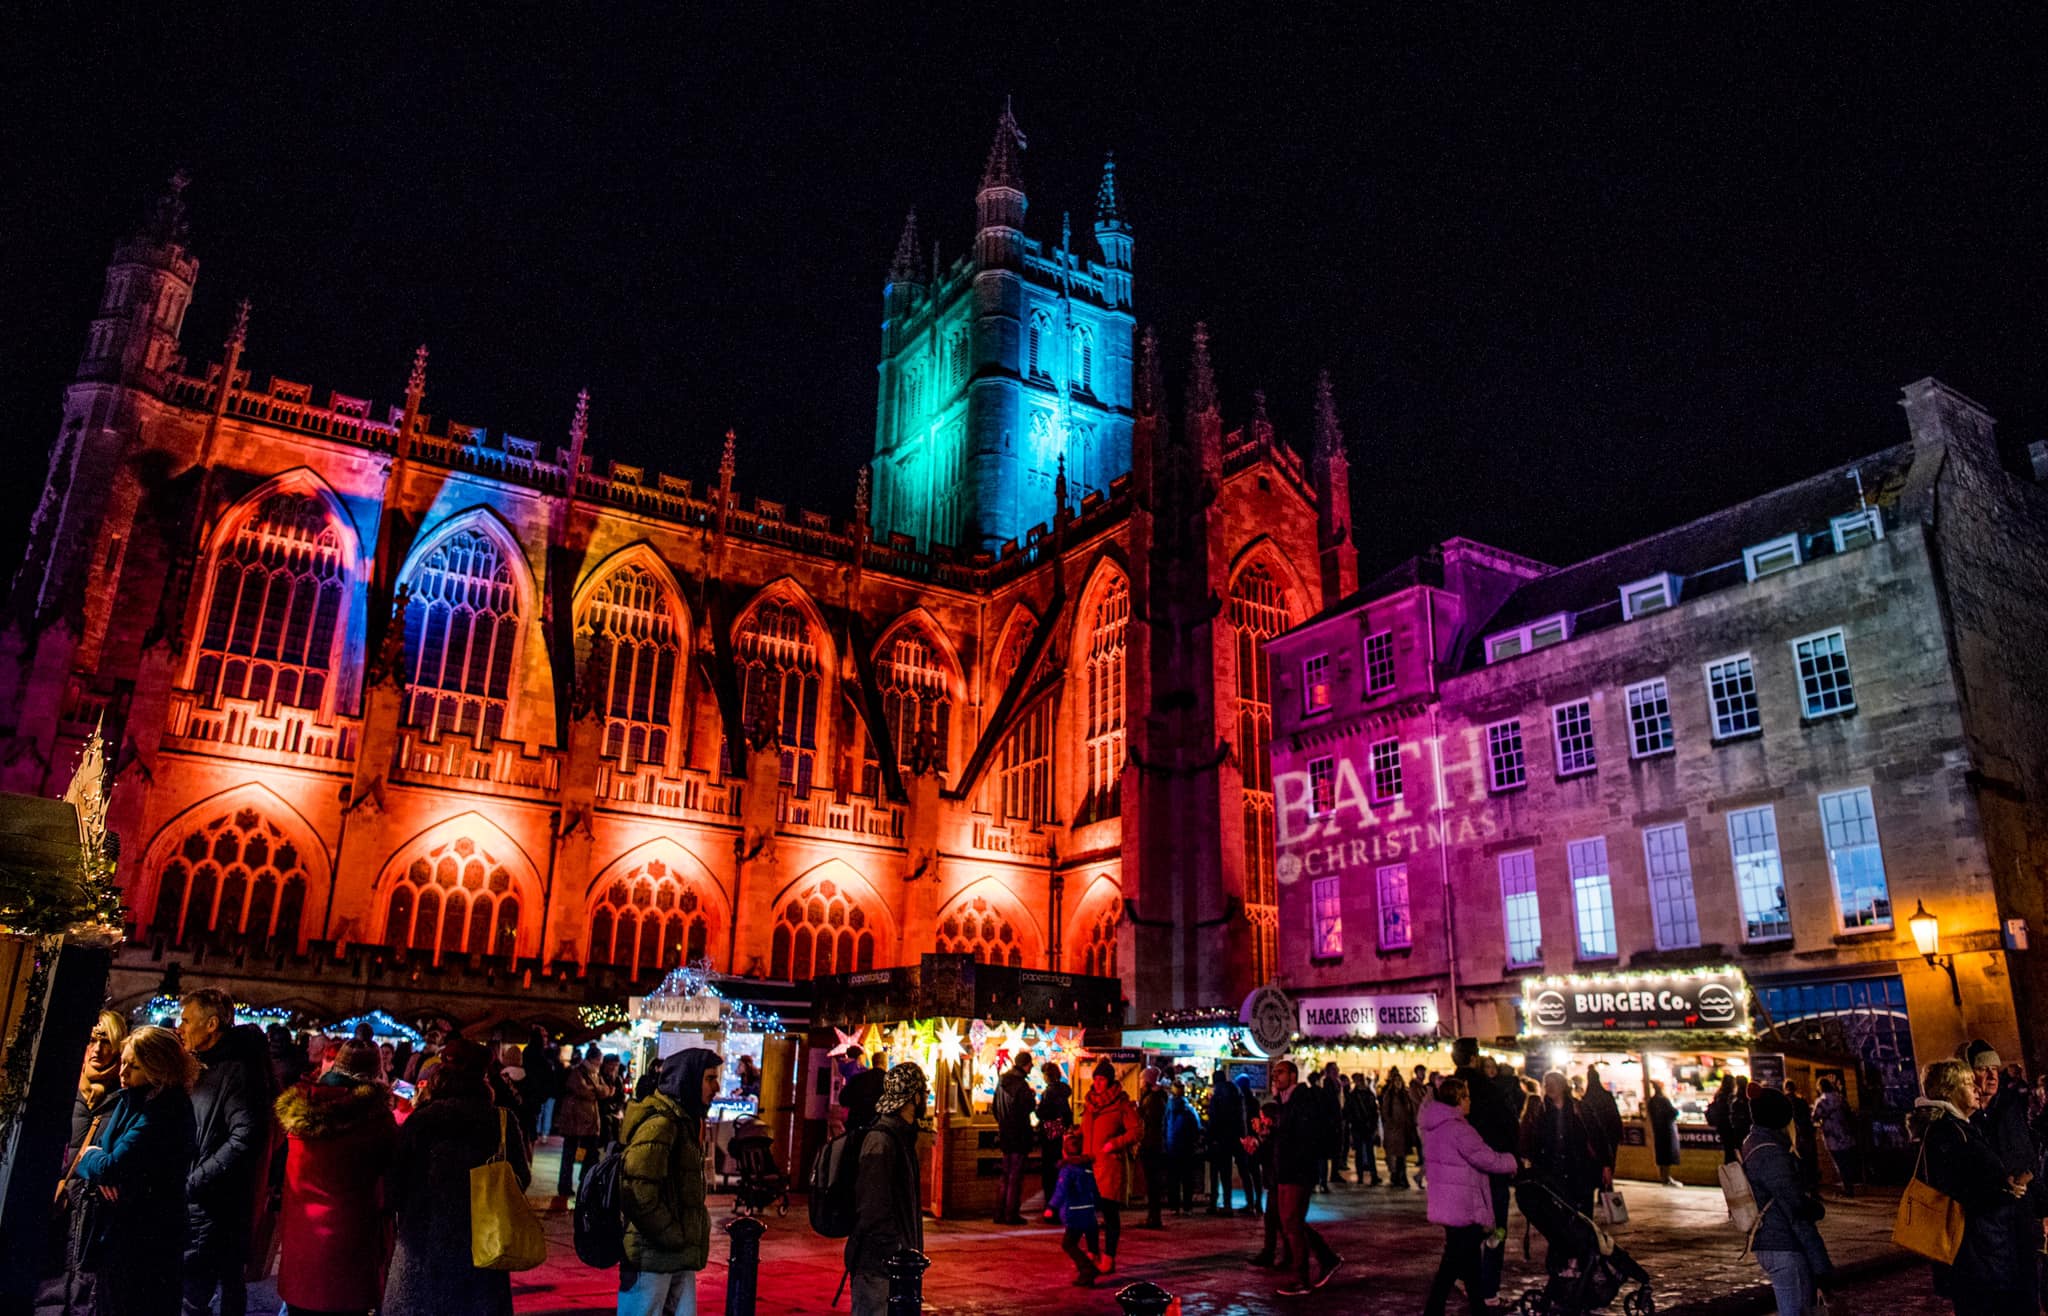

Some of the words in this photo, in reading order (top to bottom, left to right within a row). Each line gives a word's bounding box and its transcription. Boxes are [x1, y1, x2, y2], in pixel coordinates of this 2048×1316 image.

[1274, 726, 1489, 846] BATH
[1305, 808, 1497, 875] CHRISTMAS
[1306, 1007, 1374, 1026] MACARONI
[1379, 1006, 1429, 1024] CHEESE
[1574, 991, 1656, 1013] BURGER
[1658, 990, 1691, 1011] Co.
